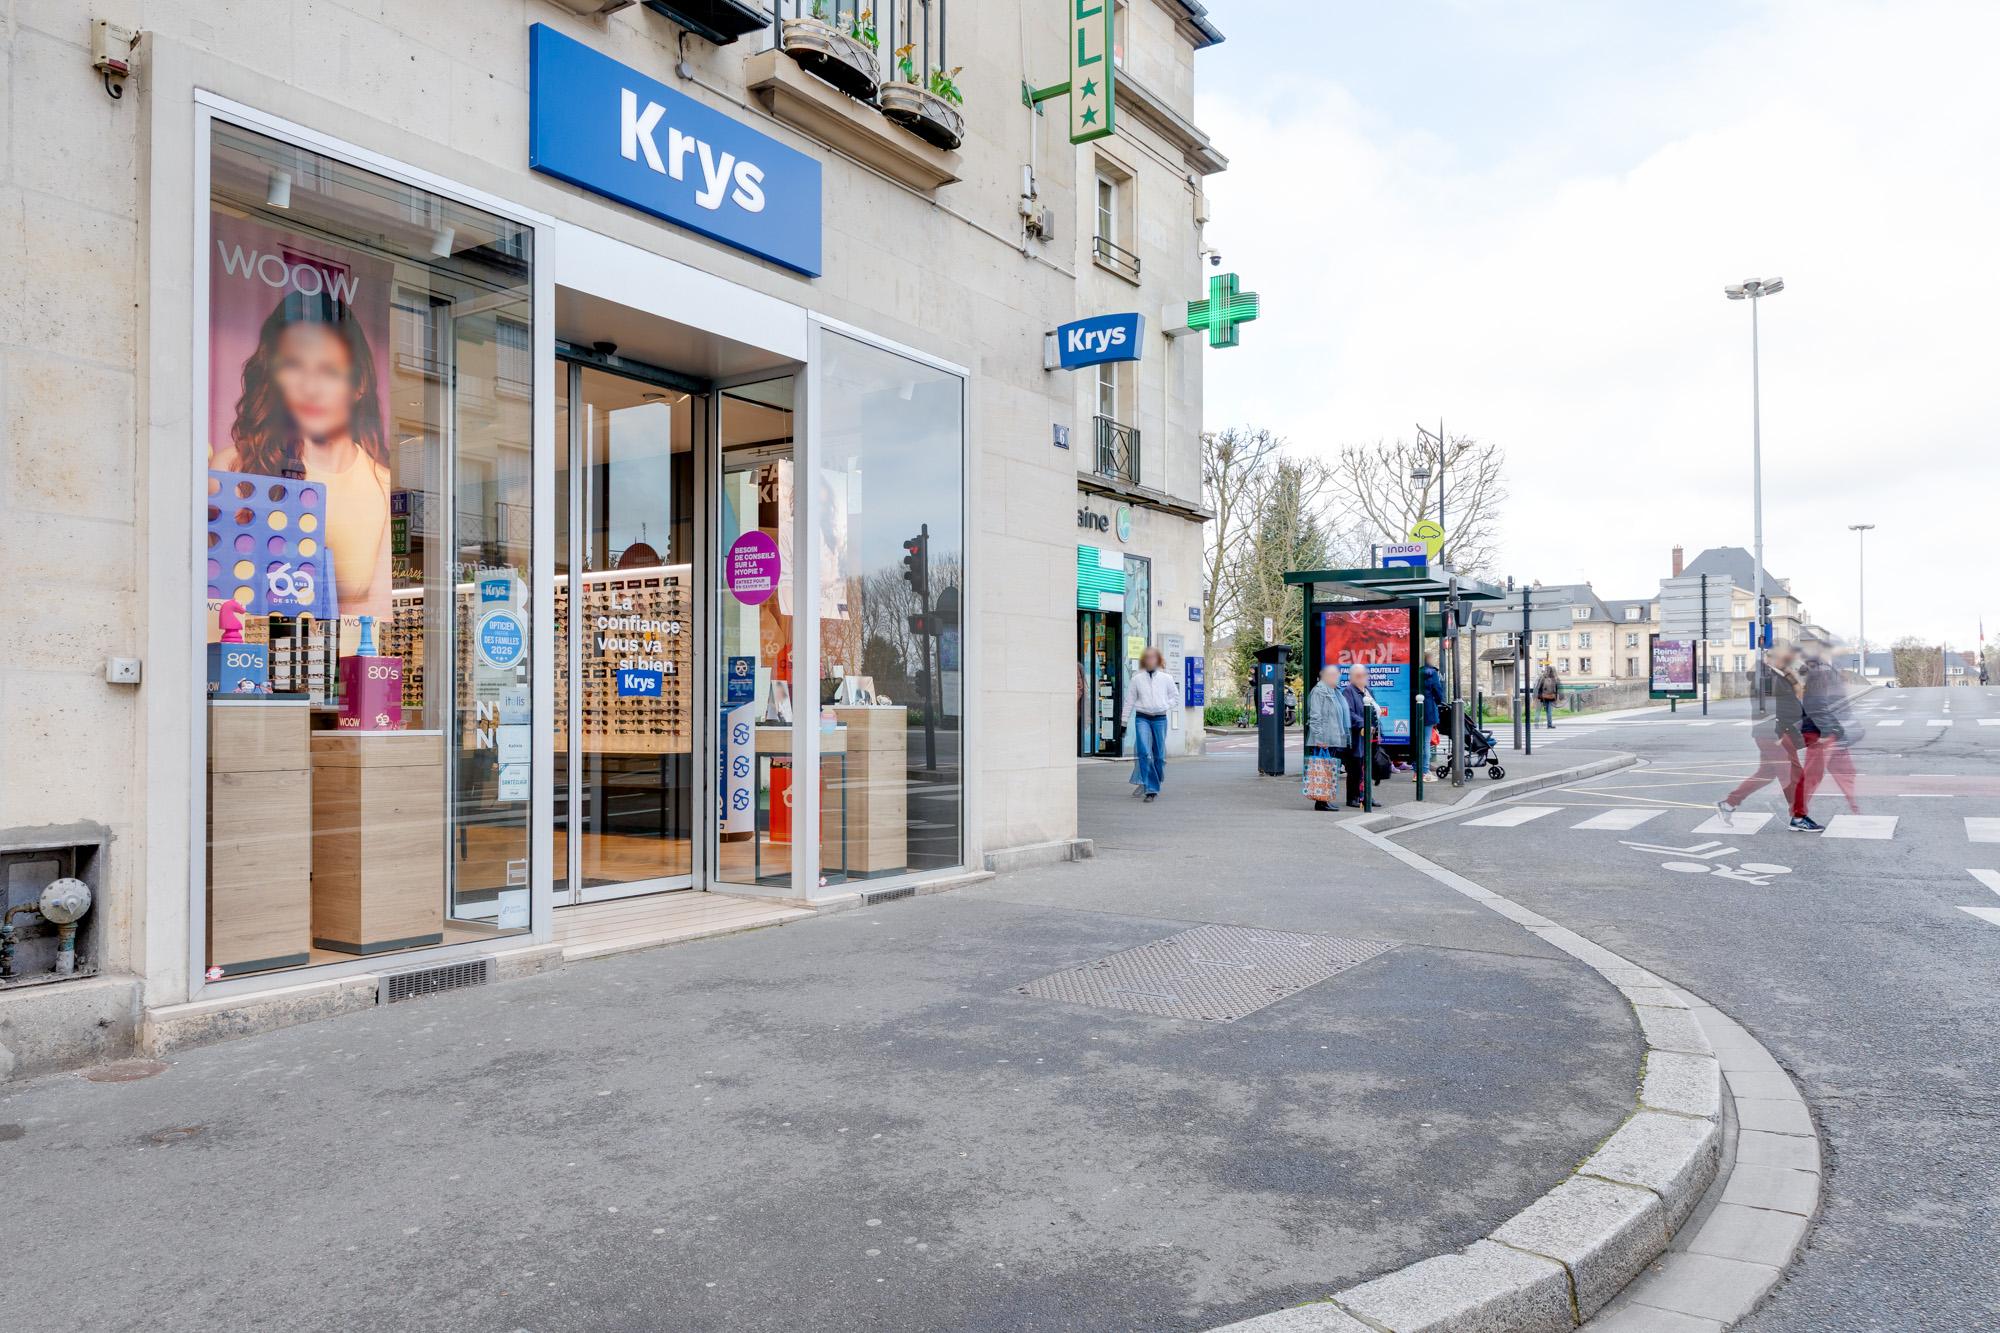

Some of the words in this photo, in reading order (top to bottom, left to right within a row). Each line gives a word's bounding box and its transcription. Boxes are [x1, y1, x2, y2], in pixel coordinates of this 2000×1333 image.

[619, 87, 766, 213] Krys
[217, 240, 359, 305] WOOW
[1068, 326, 1126, 353] Krys
[734, 546, 758, 554] BESOIN
[745, 552, 776, 560] CONSEILS
[1387, 545, 1422, 554] INDIGO
[734, 561, 748, 569] SUR
[734, 568, 759, 576] MYOPIE
[485, 585, 506, 598] Krys
[611, 590, 633, 610] La
[489, 621, 515, 630] OPTICIEN
[597, 614, 680, 634] confiance
[484, 636, 494, 644] DES
[495, 636, 519, 645] FAMILLES
[597, 637, 639, 652] vous
[642, 638, 662, 653] va
[490, 646, 512, 655] 2026
[1653, 648, 1678, 656] Reine
[227, 653, 264, 669] 80's
[620, 655, 634, 670] si
[367, 666, 399, 680] 80's
[1266, 664, 1273, 677] P
[624, 674, 656, 692] Krys
[1370, 679, 1394, 687] L'ANNÉE
[339, 717, 361, 728] WOOW
